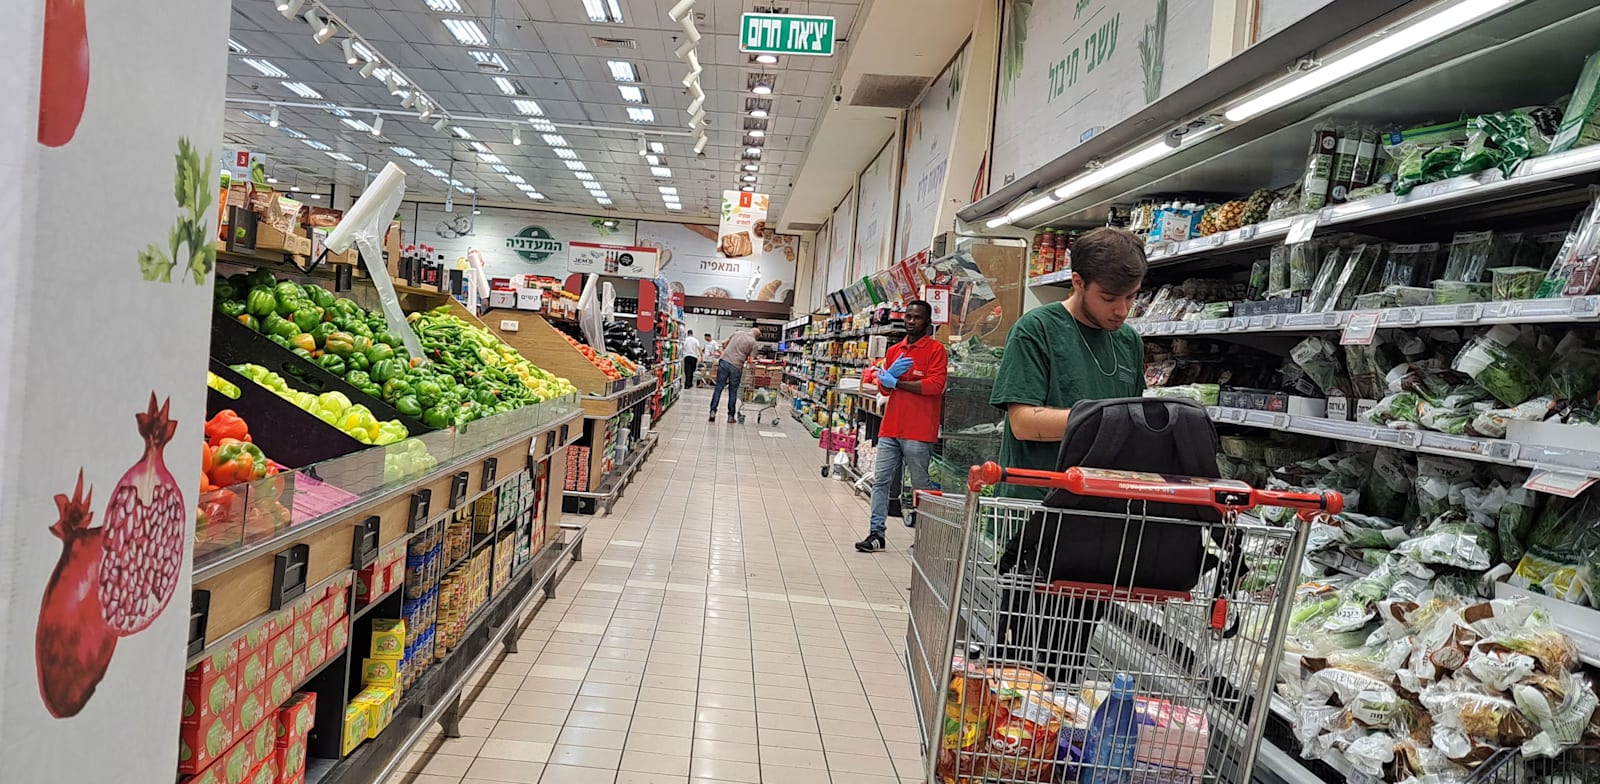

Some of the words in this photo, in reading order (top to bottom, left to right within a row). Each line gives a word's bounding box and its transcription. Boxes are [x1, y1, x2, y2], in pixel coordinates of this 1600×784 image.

[747, 18, 782, 49] חרום
[787, 21, 828, 51] יציאת
[1084, 11, 1120, 74] עשבי
[1047, 47, 1080, 104] תיבול
[239, 155, 246, 165] 3
[743, 196, 748, 206] 1
[505, 237, 562, 252] המעדניה
[699, 260, 740, 273] המאפיה
[693, 306, 733, 316] המאפיה
